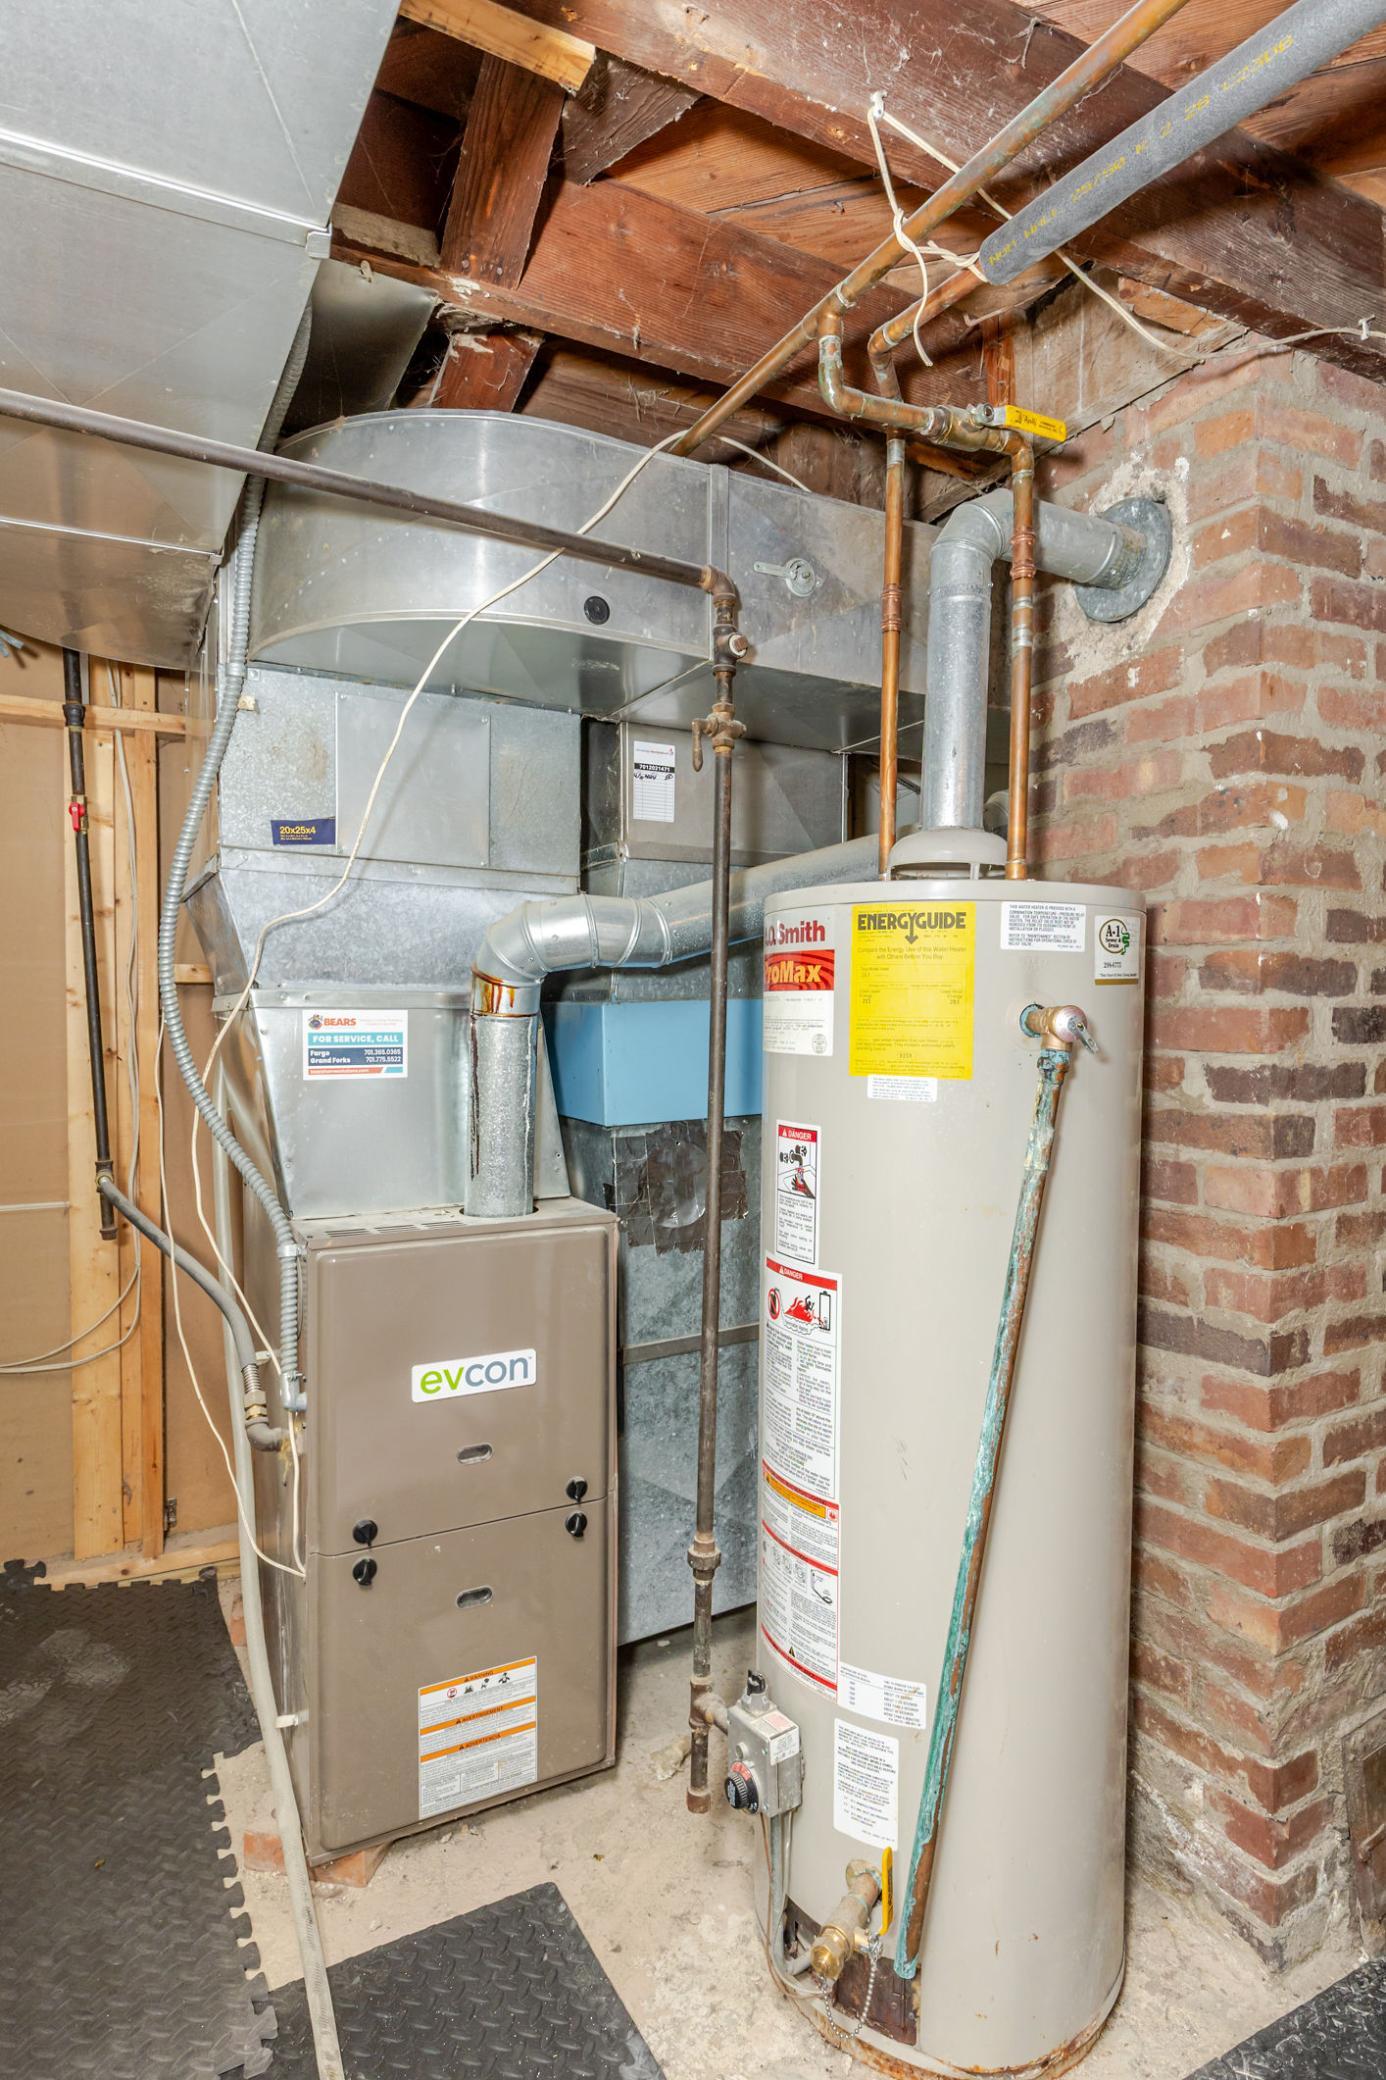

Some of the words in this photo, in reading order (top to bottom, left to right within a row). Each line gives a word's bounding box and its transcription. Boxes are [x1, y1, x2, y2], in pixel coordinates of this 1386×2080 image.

[279, 826, 316, 835] 20x25x4
[857, 911, 967, 931] ENERGYGUIDE
[778, 919, 825, 945] Smith
[323, 1018, 357, 1026] BEARS
[312, 1035, 332, 1043] FOR
[334, 1035, 374, 1043] SERVICE,
[376, 1034, 399, 1043] CALL
[788, 1129, 812, 1141] DANGER
[783, 1267, 803, 1281] DANGER
[420, 1356, 528, 1395] evcon
